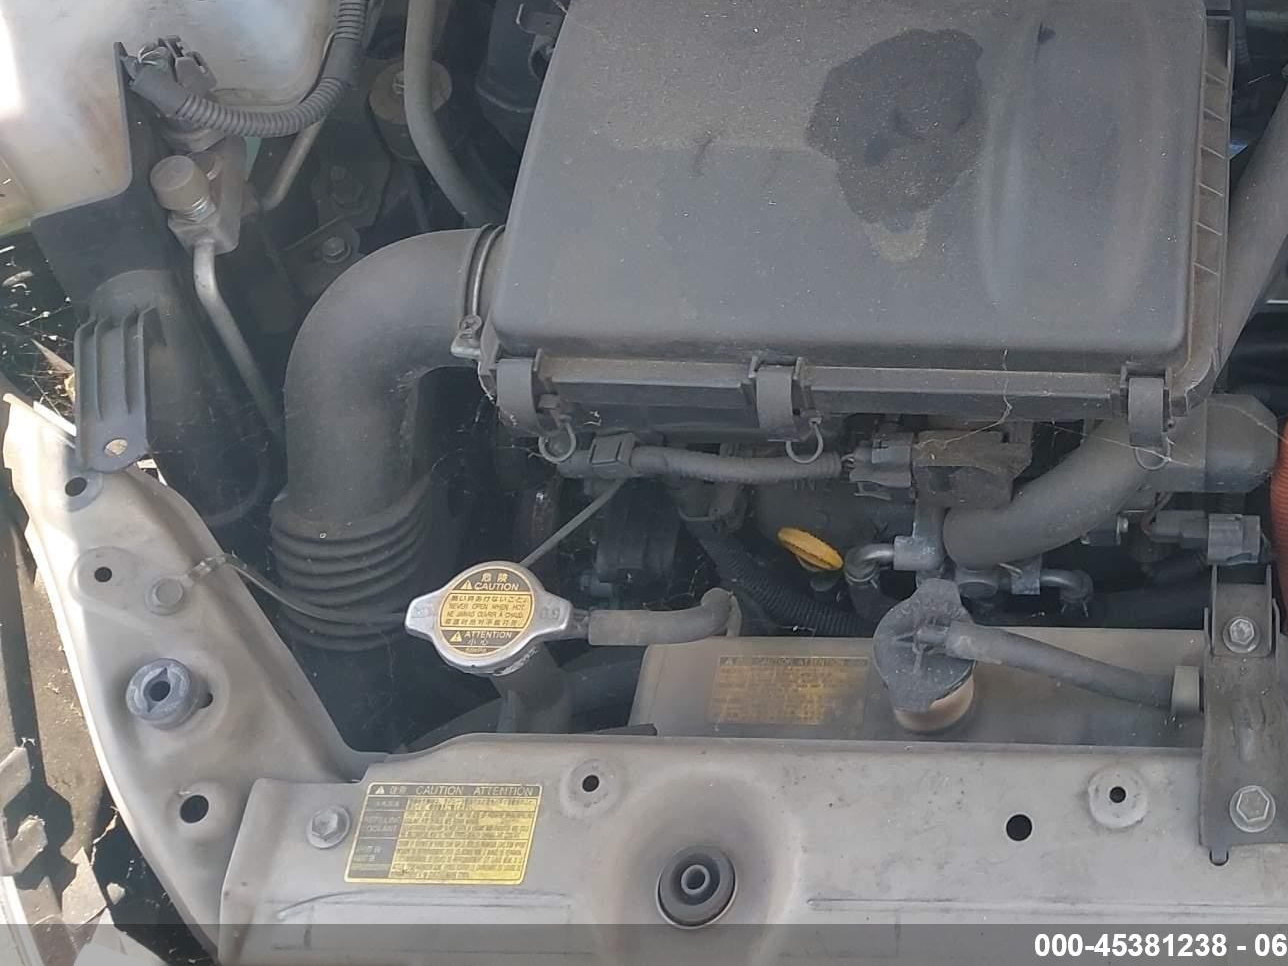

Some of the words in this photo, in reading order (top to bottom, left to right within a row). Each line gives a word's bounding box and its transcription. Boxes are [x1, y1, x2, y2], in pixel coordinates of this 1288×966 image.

[474, 582, 519, 592] CAUTION
[463, 630, 512, 639] ATTENTION
[415, 785, 464, 796] CAUTION
[472, 786, 534, 797] ATTENTION
